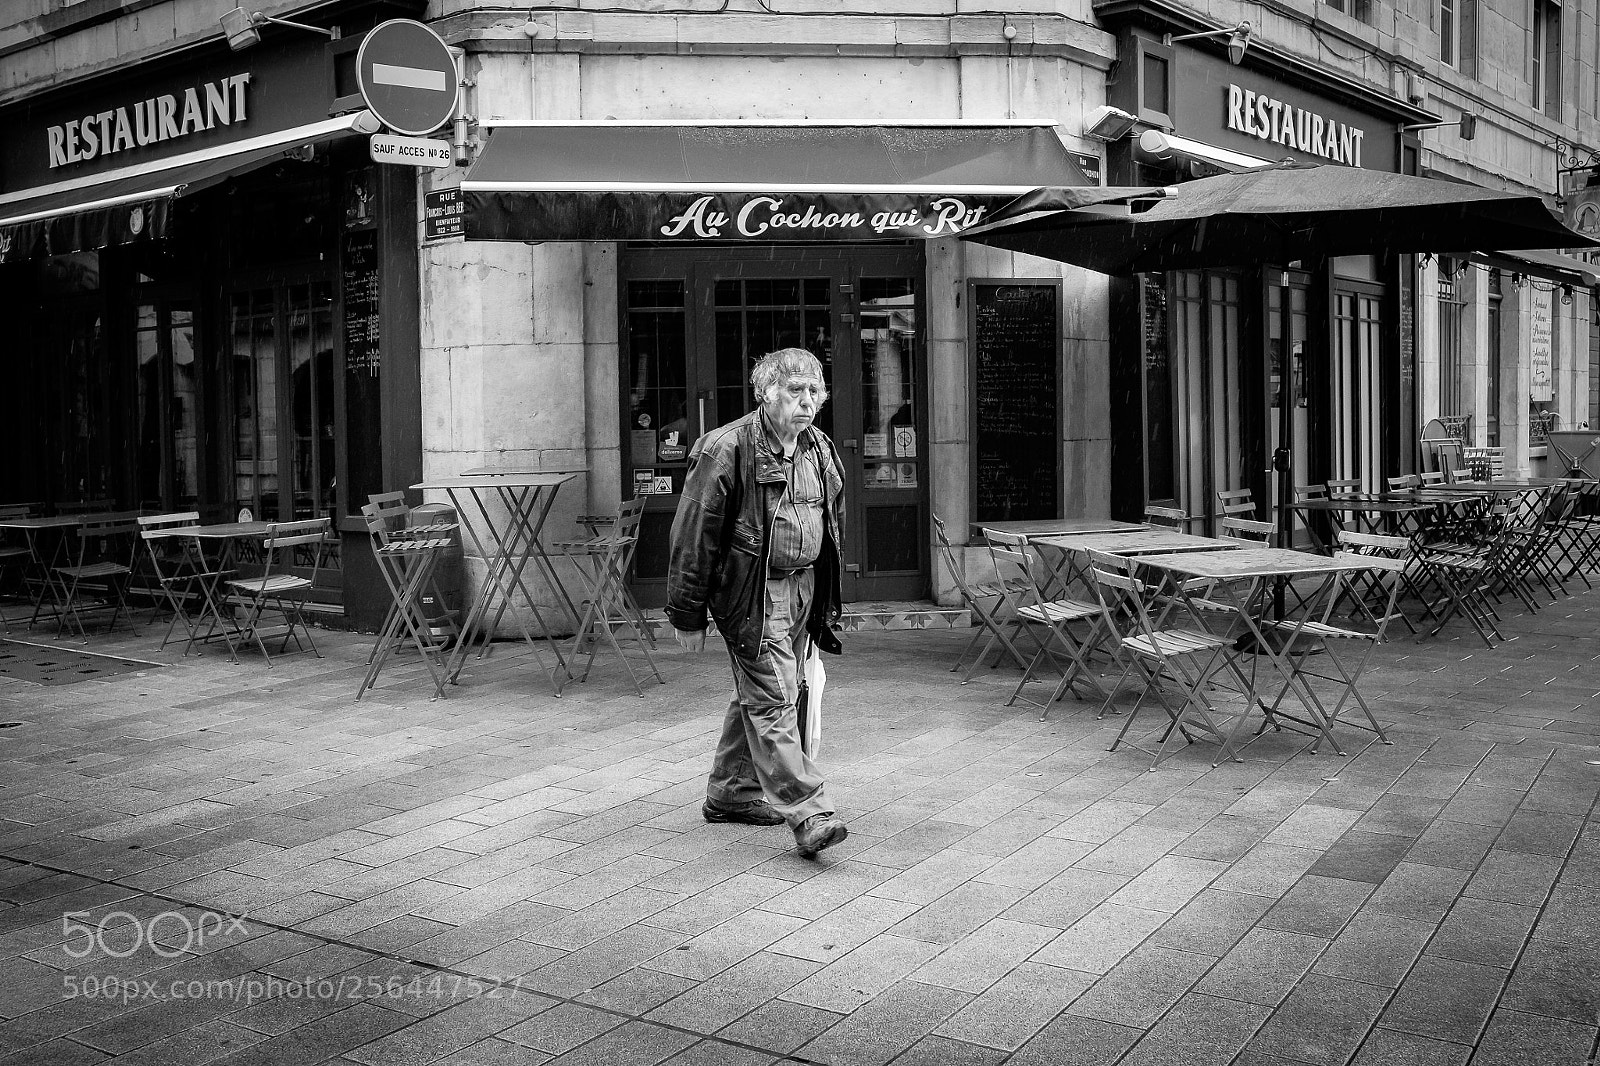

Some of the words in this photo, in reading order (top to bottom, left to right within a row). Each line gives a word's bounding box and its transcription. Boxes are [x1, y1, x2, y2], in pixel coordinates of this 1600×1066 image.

[47, 72, 250, 168] RESTAURANT
[1228, 83, 1364, 168] RESTAURANT
[374, 144, 395, 155] SAUF
[399, 146, 425, 157] ACCES
[439, 149, 450, 160] 26
[439, 192, 456, 202] RUE
[661, 195, 729, 238] Au
[737, 196, 865, 237] Cochon
[870, 208, 922, 234] qui
[923, 197, 988, 235] Rit
